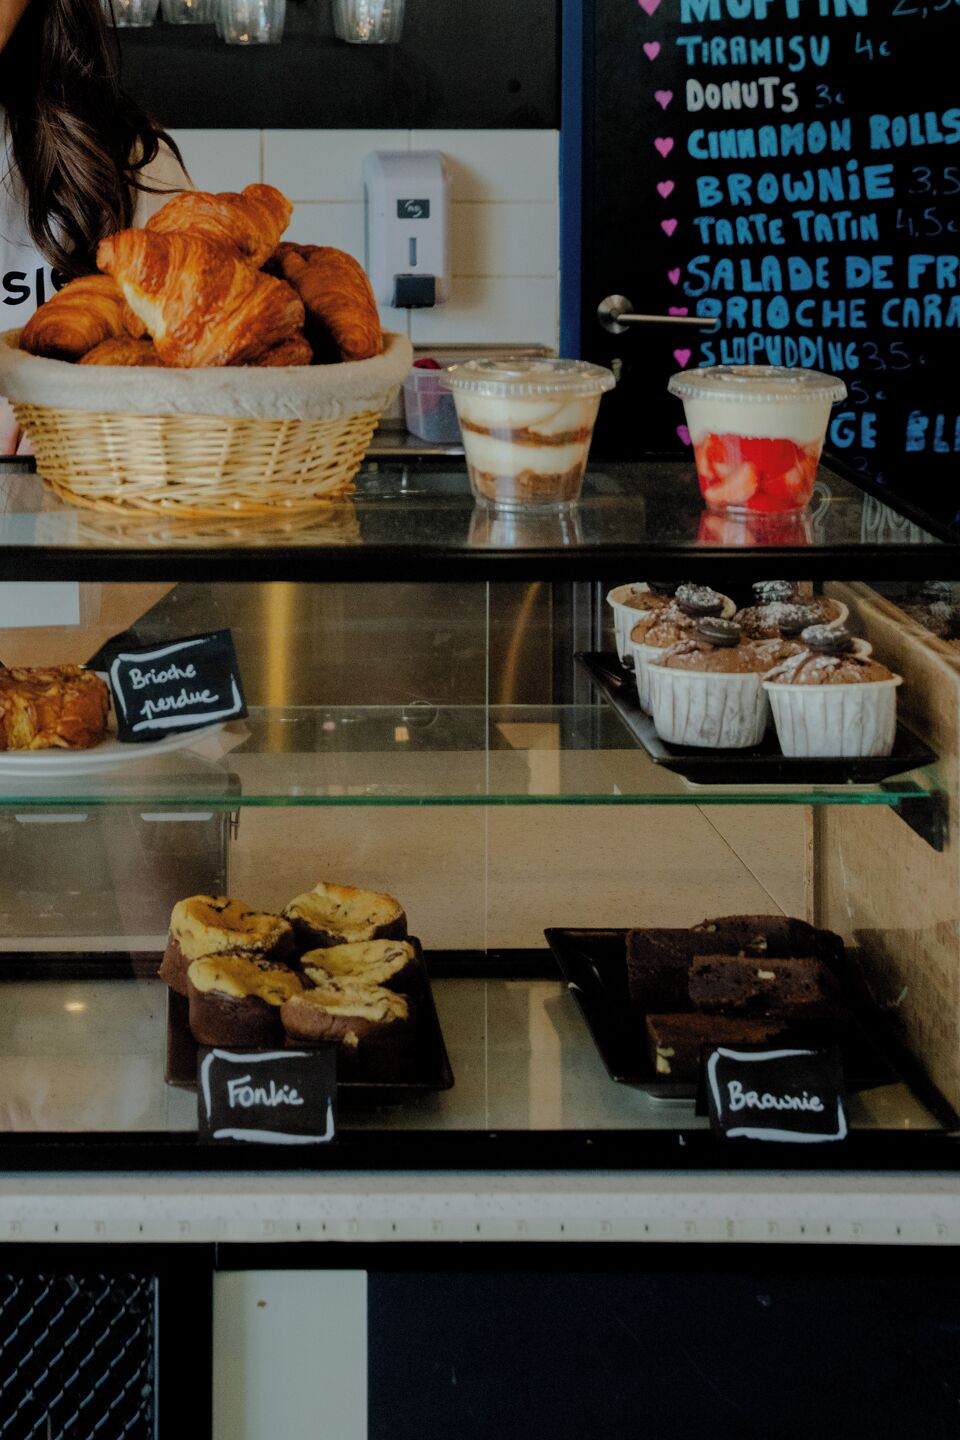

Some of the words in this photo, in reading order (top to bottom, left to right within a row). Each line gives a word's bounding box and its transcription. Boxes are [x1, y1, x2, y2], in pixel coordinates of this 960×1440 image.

[686, 76, 799, 113] DONUTS
[687, 118, 851, 159] CINNAMON
[869, 108, 960, 150] ROLLS
[693, 212, 785, 246] TARTE
[683, 255, 829, 297] SALADE
[845, 254, 894, 290] DE
[696, 295, 867, 334] BRIOCHE
[825, 411, 878, 449] GE
[129, 663, 196, 690] Brioche
[140, 688, 219, 720] perdue
[227, 1074, 305, 1108] Fonkie
[727, 1080, 825, 1112] Brownie
